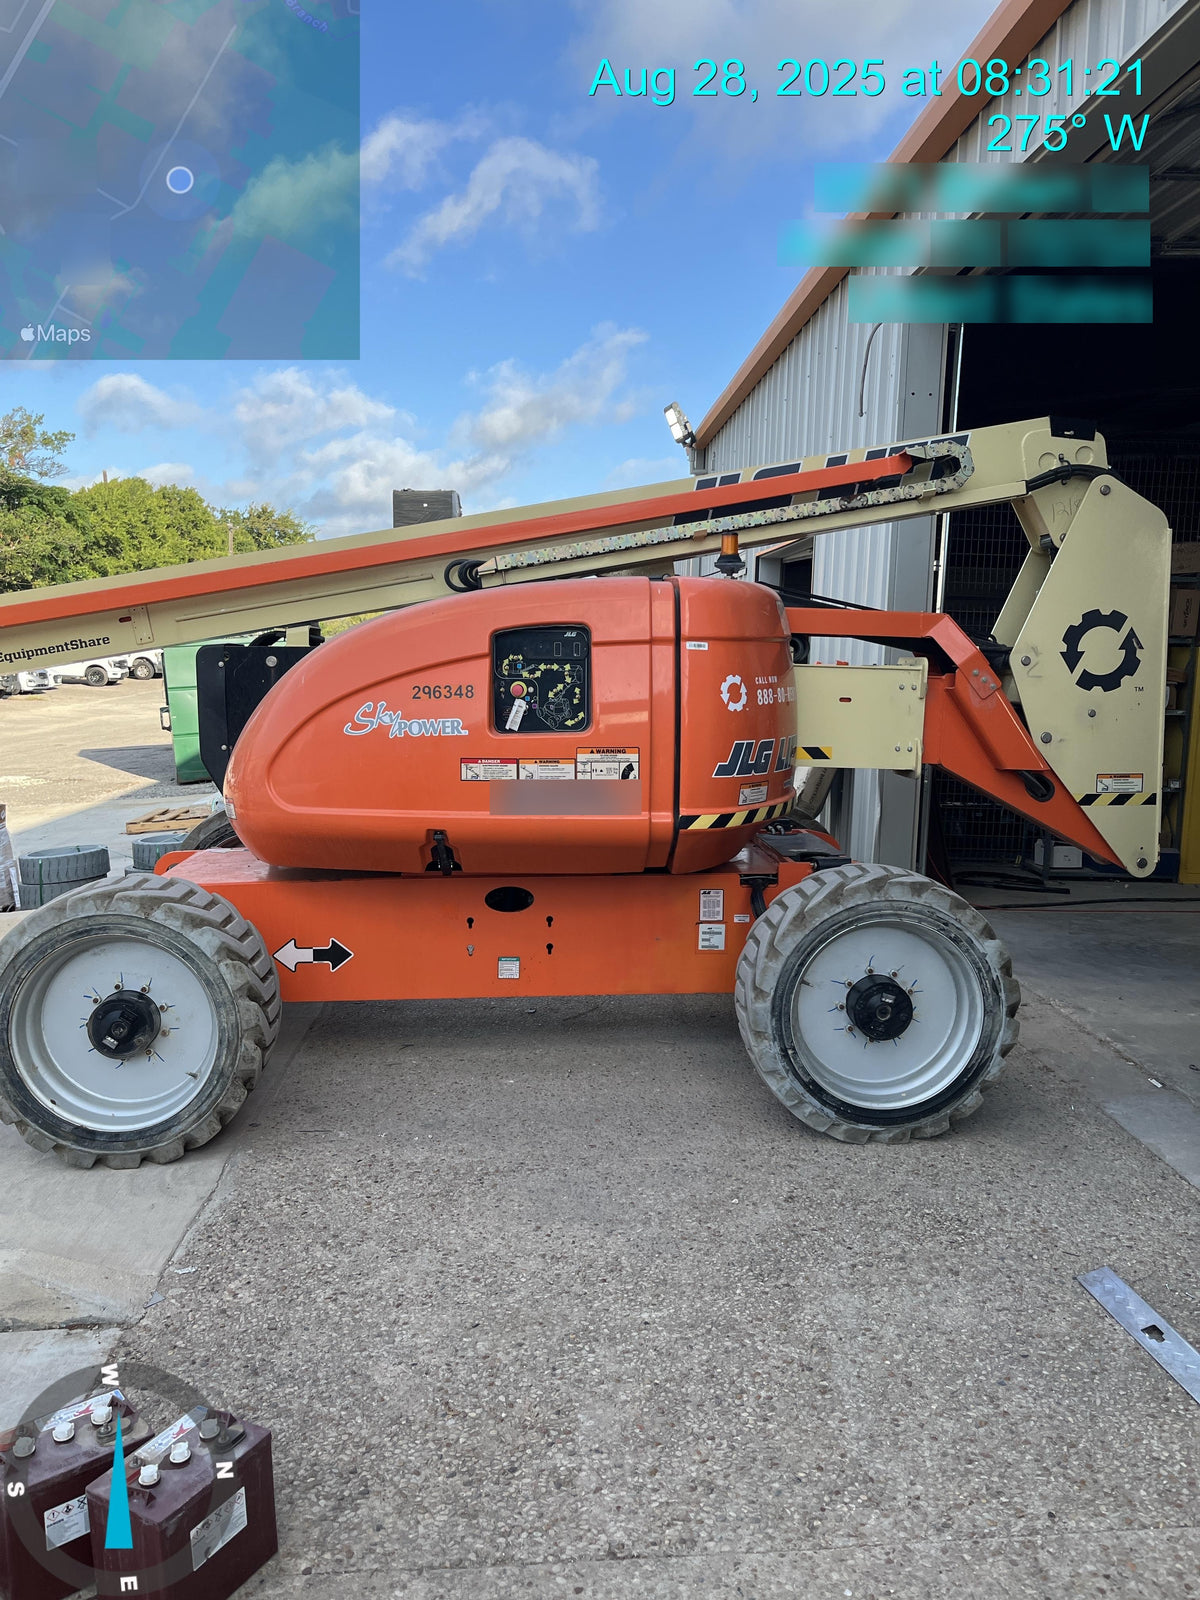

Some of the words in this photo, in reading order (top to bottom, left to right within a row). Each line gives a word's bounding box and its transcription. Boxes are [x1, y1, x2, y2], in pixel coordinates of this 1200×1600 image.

[0, 636, 111, 663] EquipmentShare
[755, 676, 768, 685] CALL
[412, 684, 475, 700] 296348
[712, 739, 775, 778] JLG
